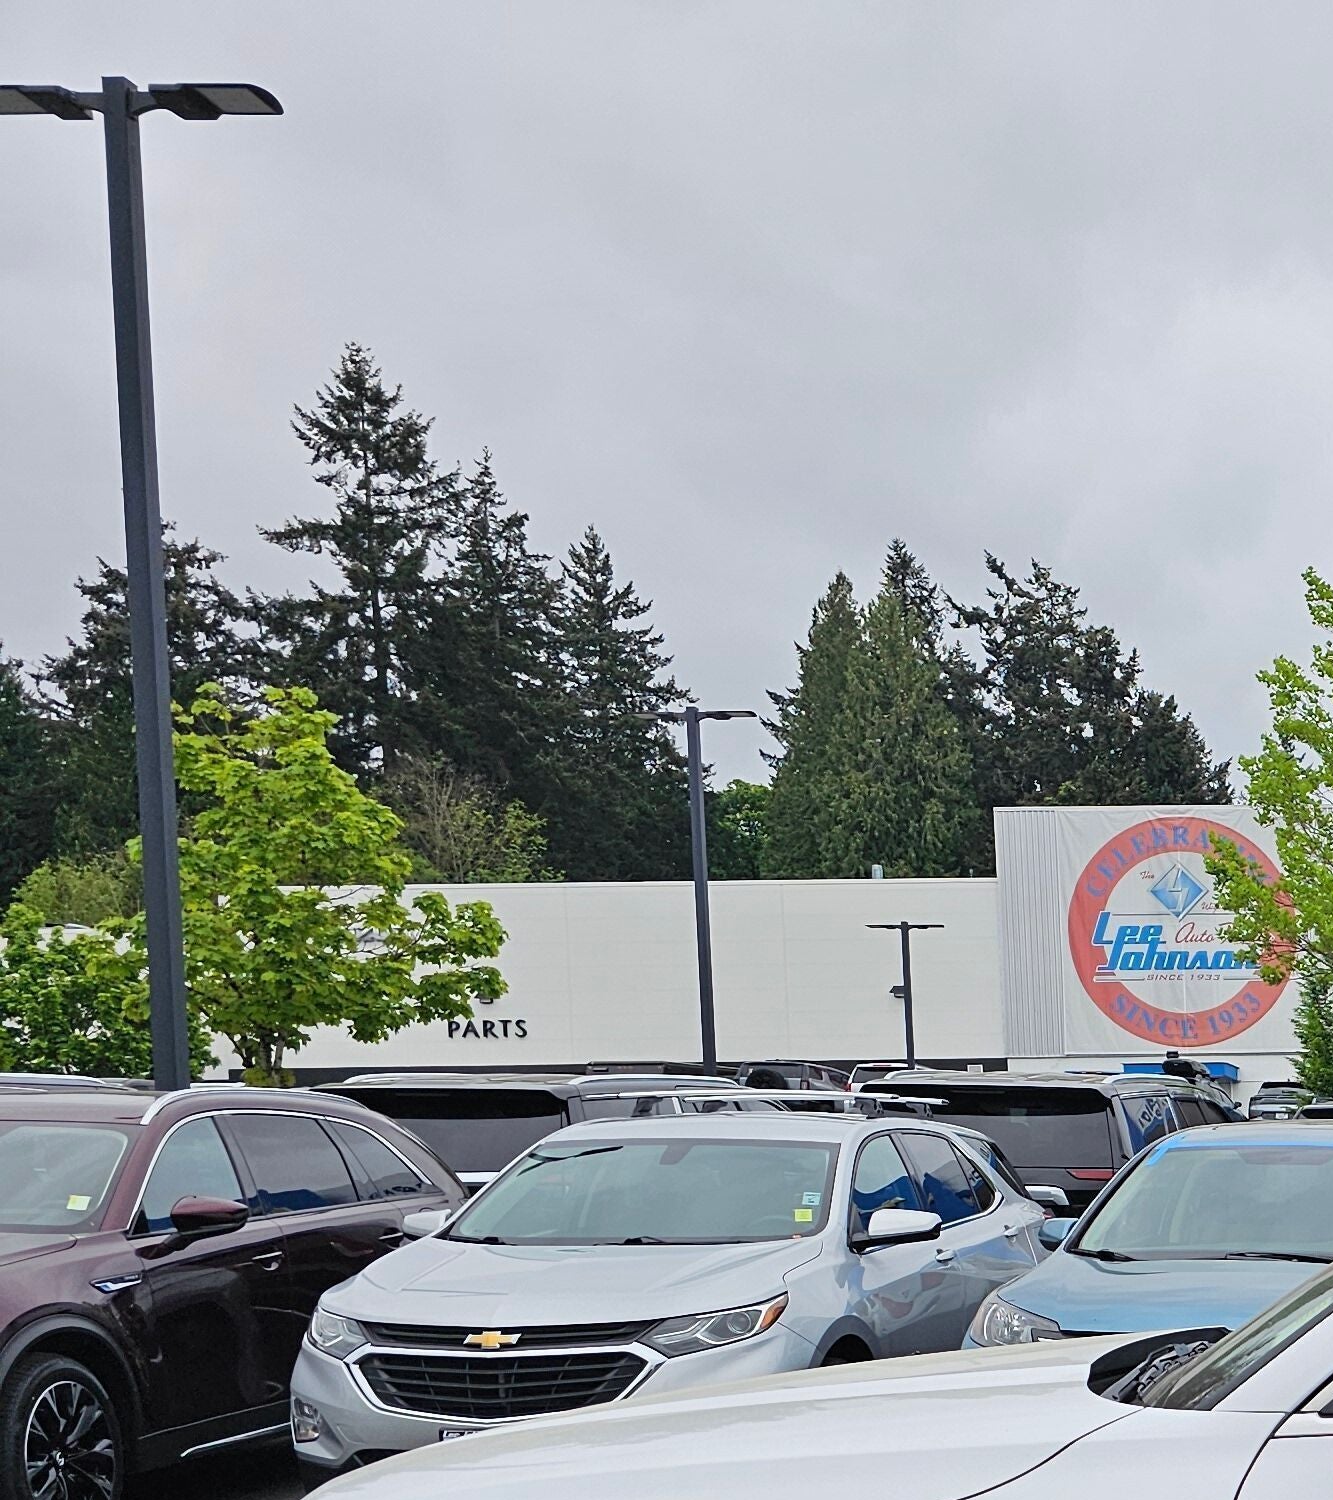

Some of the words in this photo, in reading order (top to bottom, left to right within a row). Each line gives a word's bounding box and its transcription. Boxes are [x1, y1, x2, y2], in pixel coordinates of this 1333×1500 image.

[1092, 911, 1165, 944] Lee
[1175, 922, 1215, 943] Auto
[447, 1018, 528, 1039] PARTS
[1110, 993, 1198, 1041] SINCE
[1207, 991, 1261, 1036] 1933
